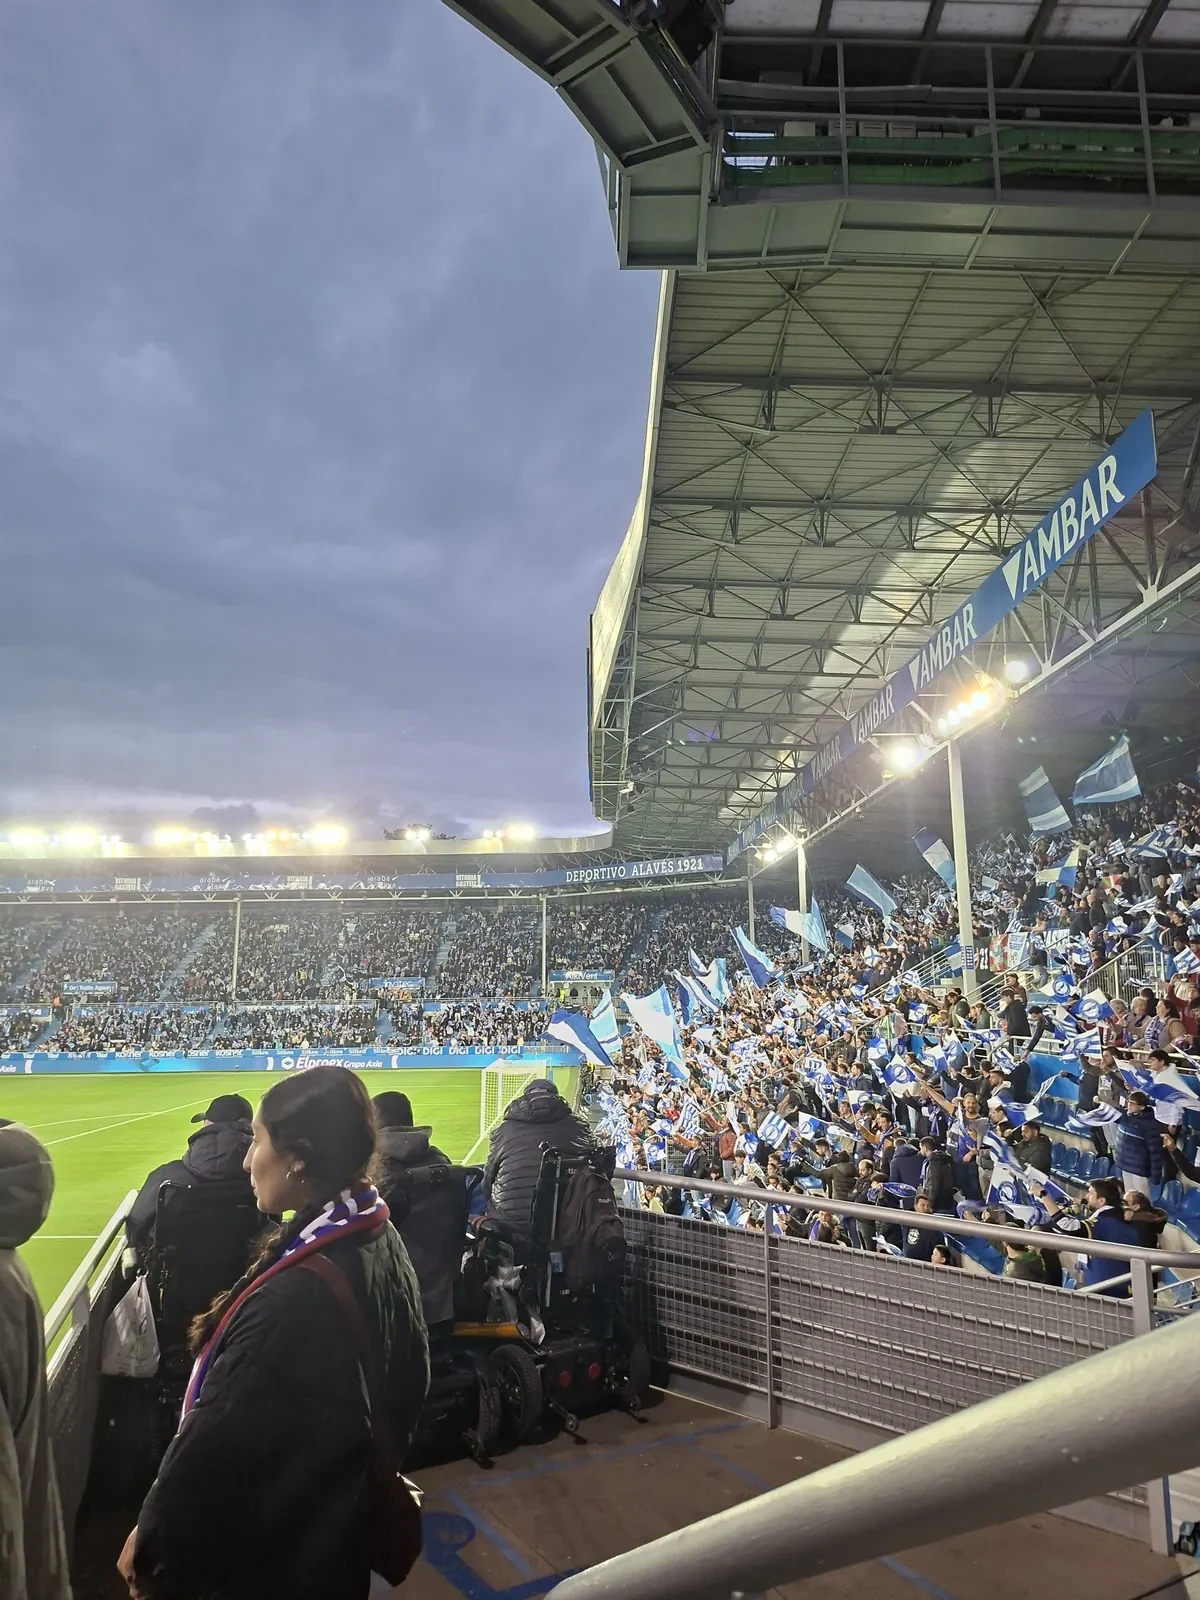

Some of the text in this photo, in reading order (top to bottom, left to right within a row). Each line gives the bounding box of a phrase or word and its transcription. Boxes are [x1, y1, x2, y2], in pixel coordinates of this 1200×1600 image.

[1022, 455, 1126, 593] AMBAR
[920, 602, 978, 689] AMBAR
[858, 683, 896, 743] AMBAR
[565, 866, 626, 883] DEPORTIVO
[677, 858, 704, 873] 1921
[422, 1046, 443, 1056] DIGI
[448, 1046, 468, 1056] DIGI
[474, 1046, 495, 1055] DIGI
[344, 1060, 366, 1069] Grupo
[366, 1059, 383, 1068] Axia
